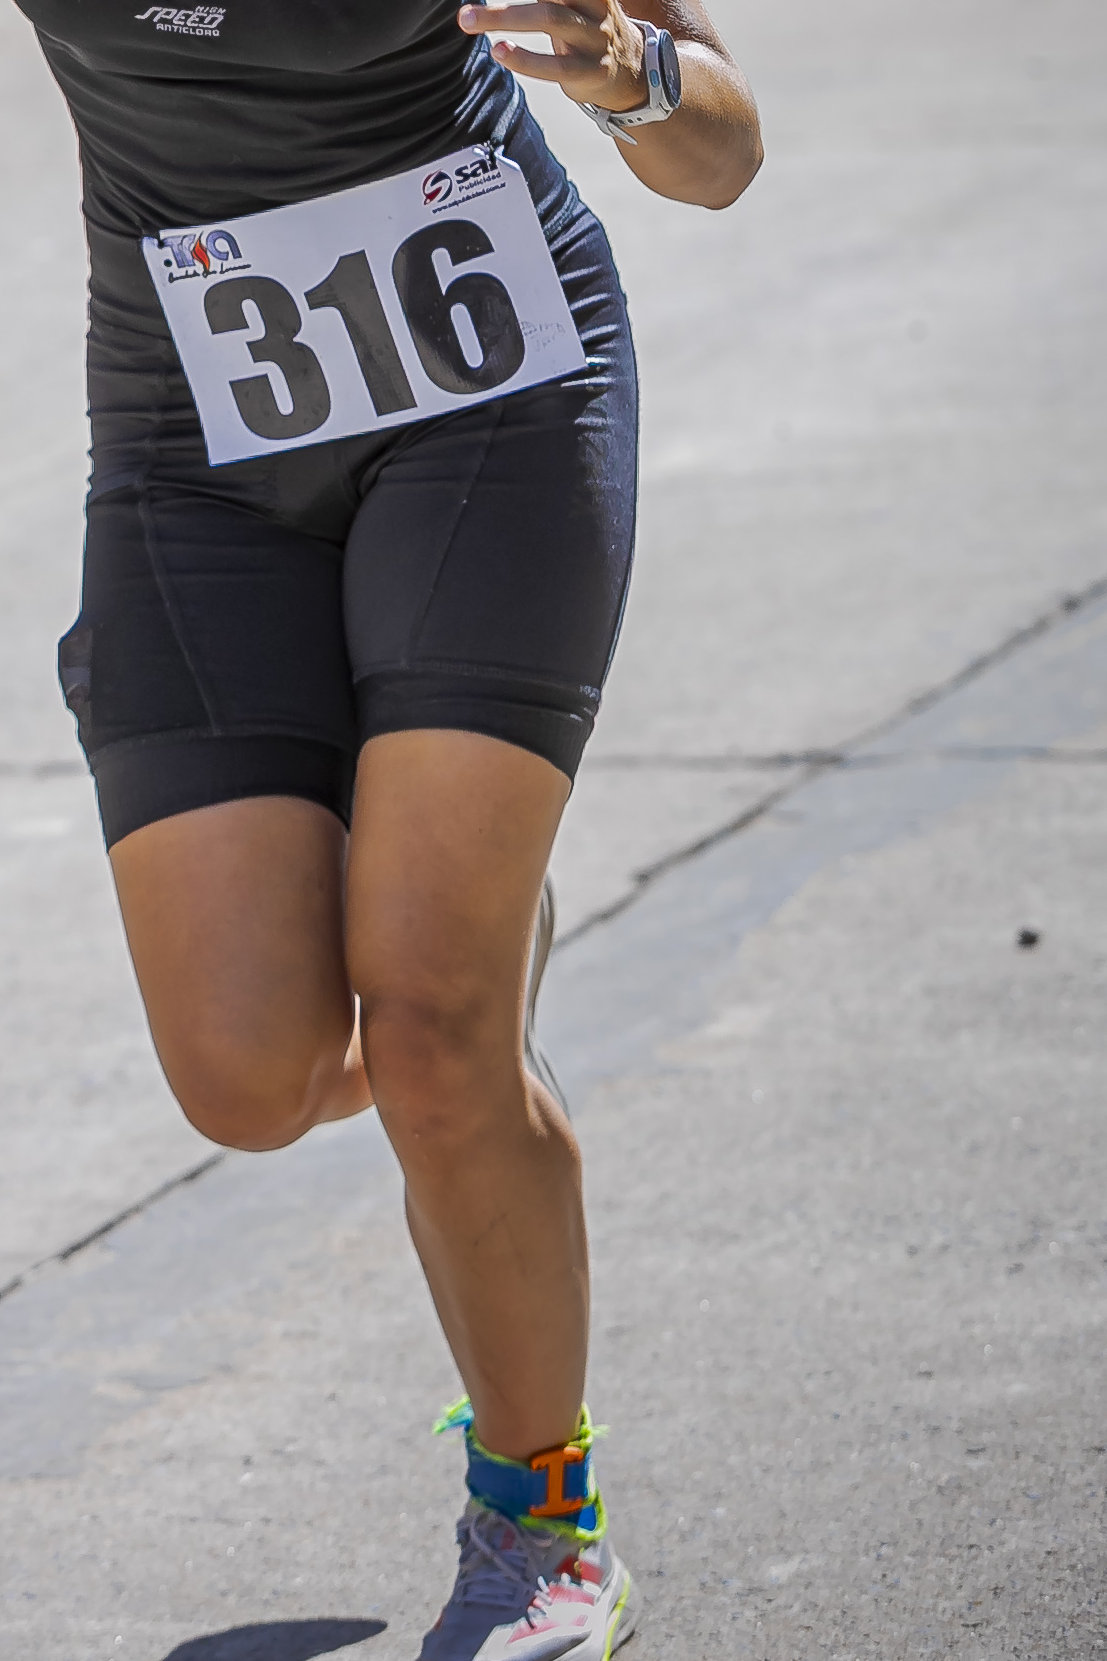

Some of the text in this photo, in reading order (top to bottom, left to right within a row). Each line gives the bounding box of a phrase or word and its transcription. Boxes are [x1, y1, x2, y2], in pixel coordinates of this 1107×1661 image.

[134, 6, 224, 28] SPEED
[458, 171, 502, 193] Publicidad
[203, 219, 526, 440] 316
